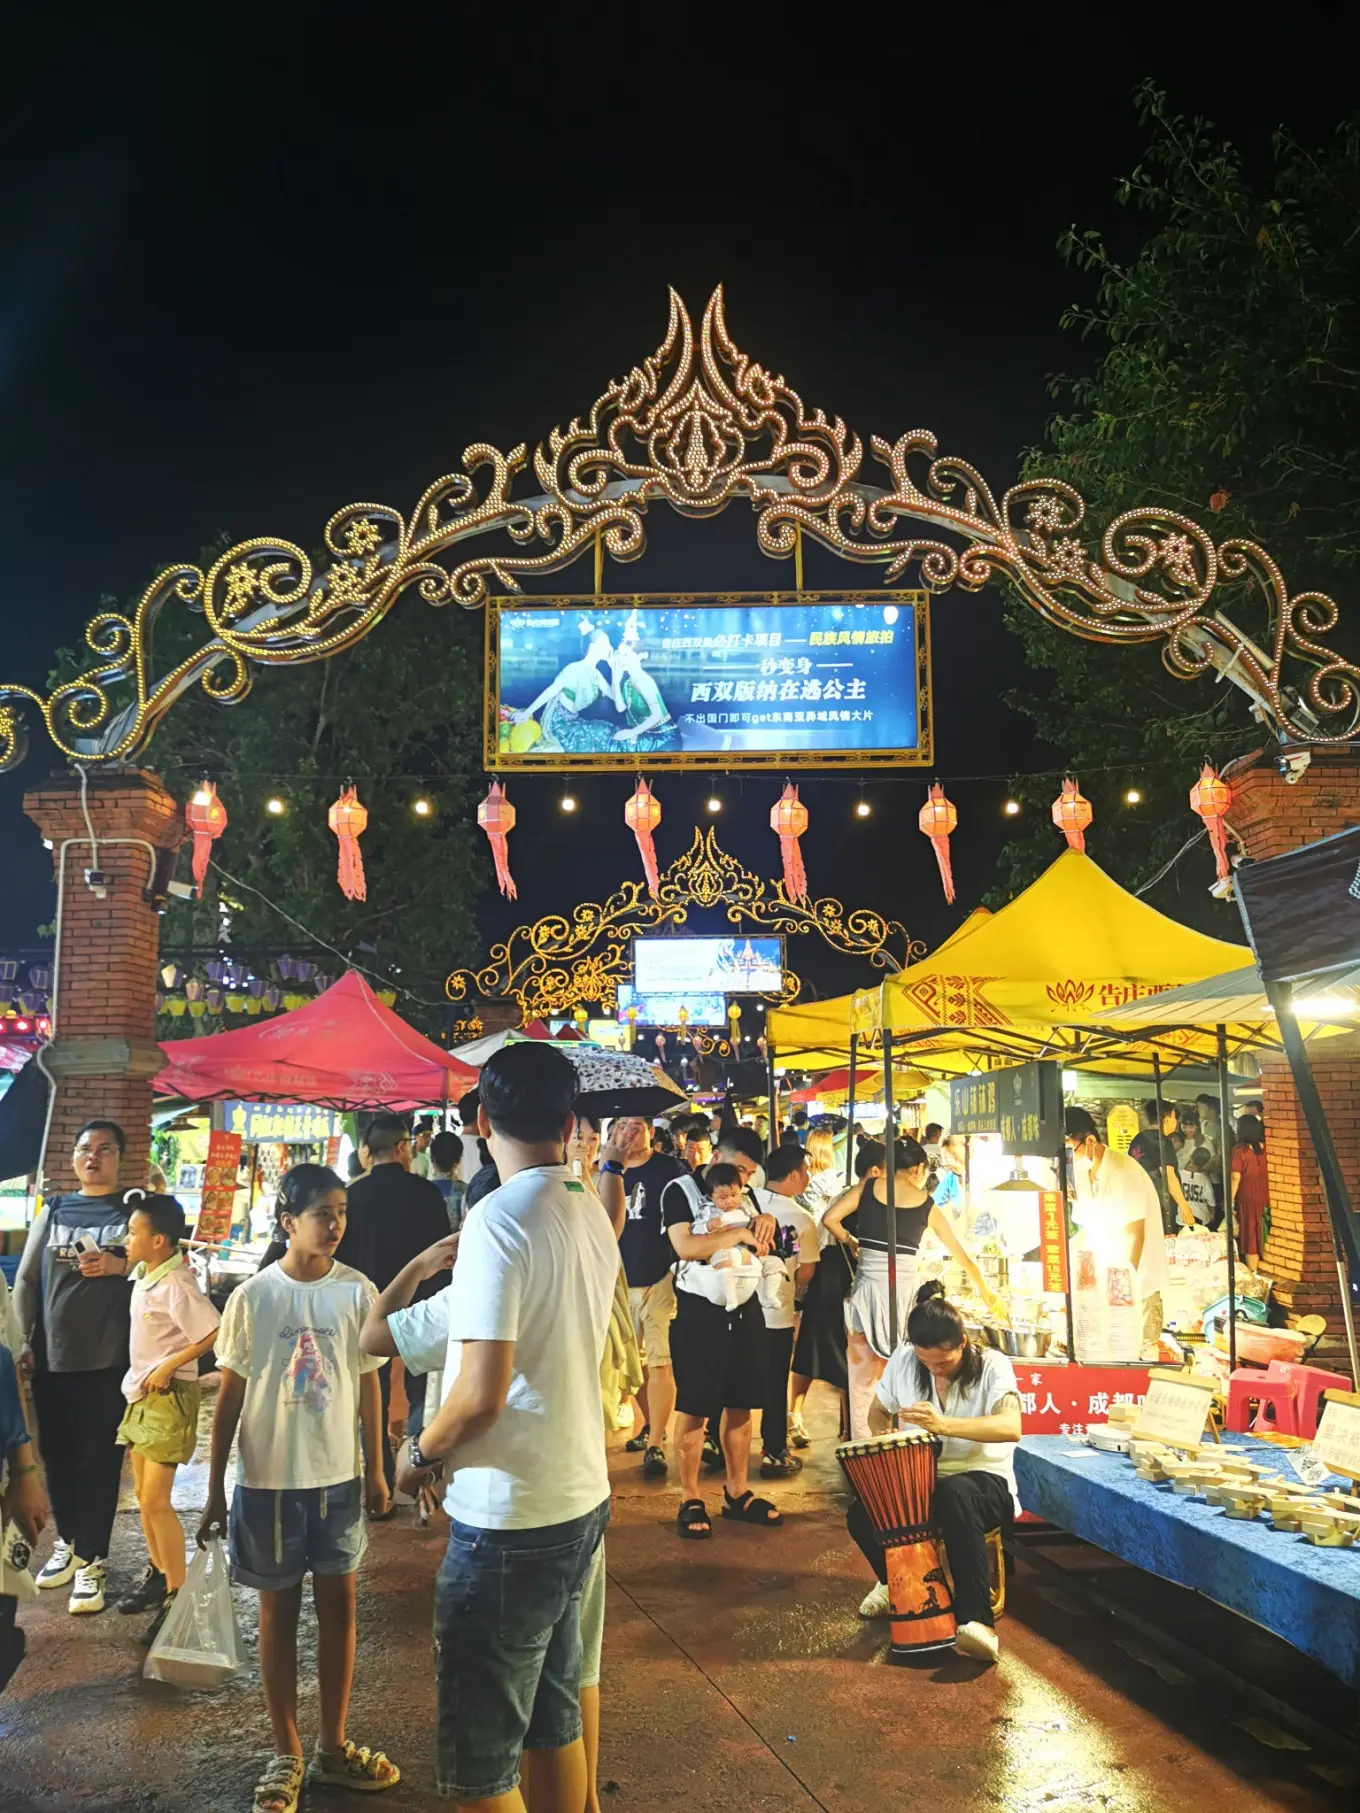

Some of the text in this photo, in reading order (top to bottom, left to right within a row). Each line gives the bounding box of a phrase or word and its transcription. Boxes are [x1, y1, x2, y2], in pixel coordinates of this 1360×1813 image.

[759, 656, 813, 676] 秒变身
[690, 678, 867, 703] 西双版纳在逃公主
